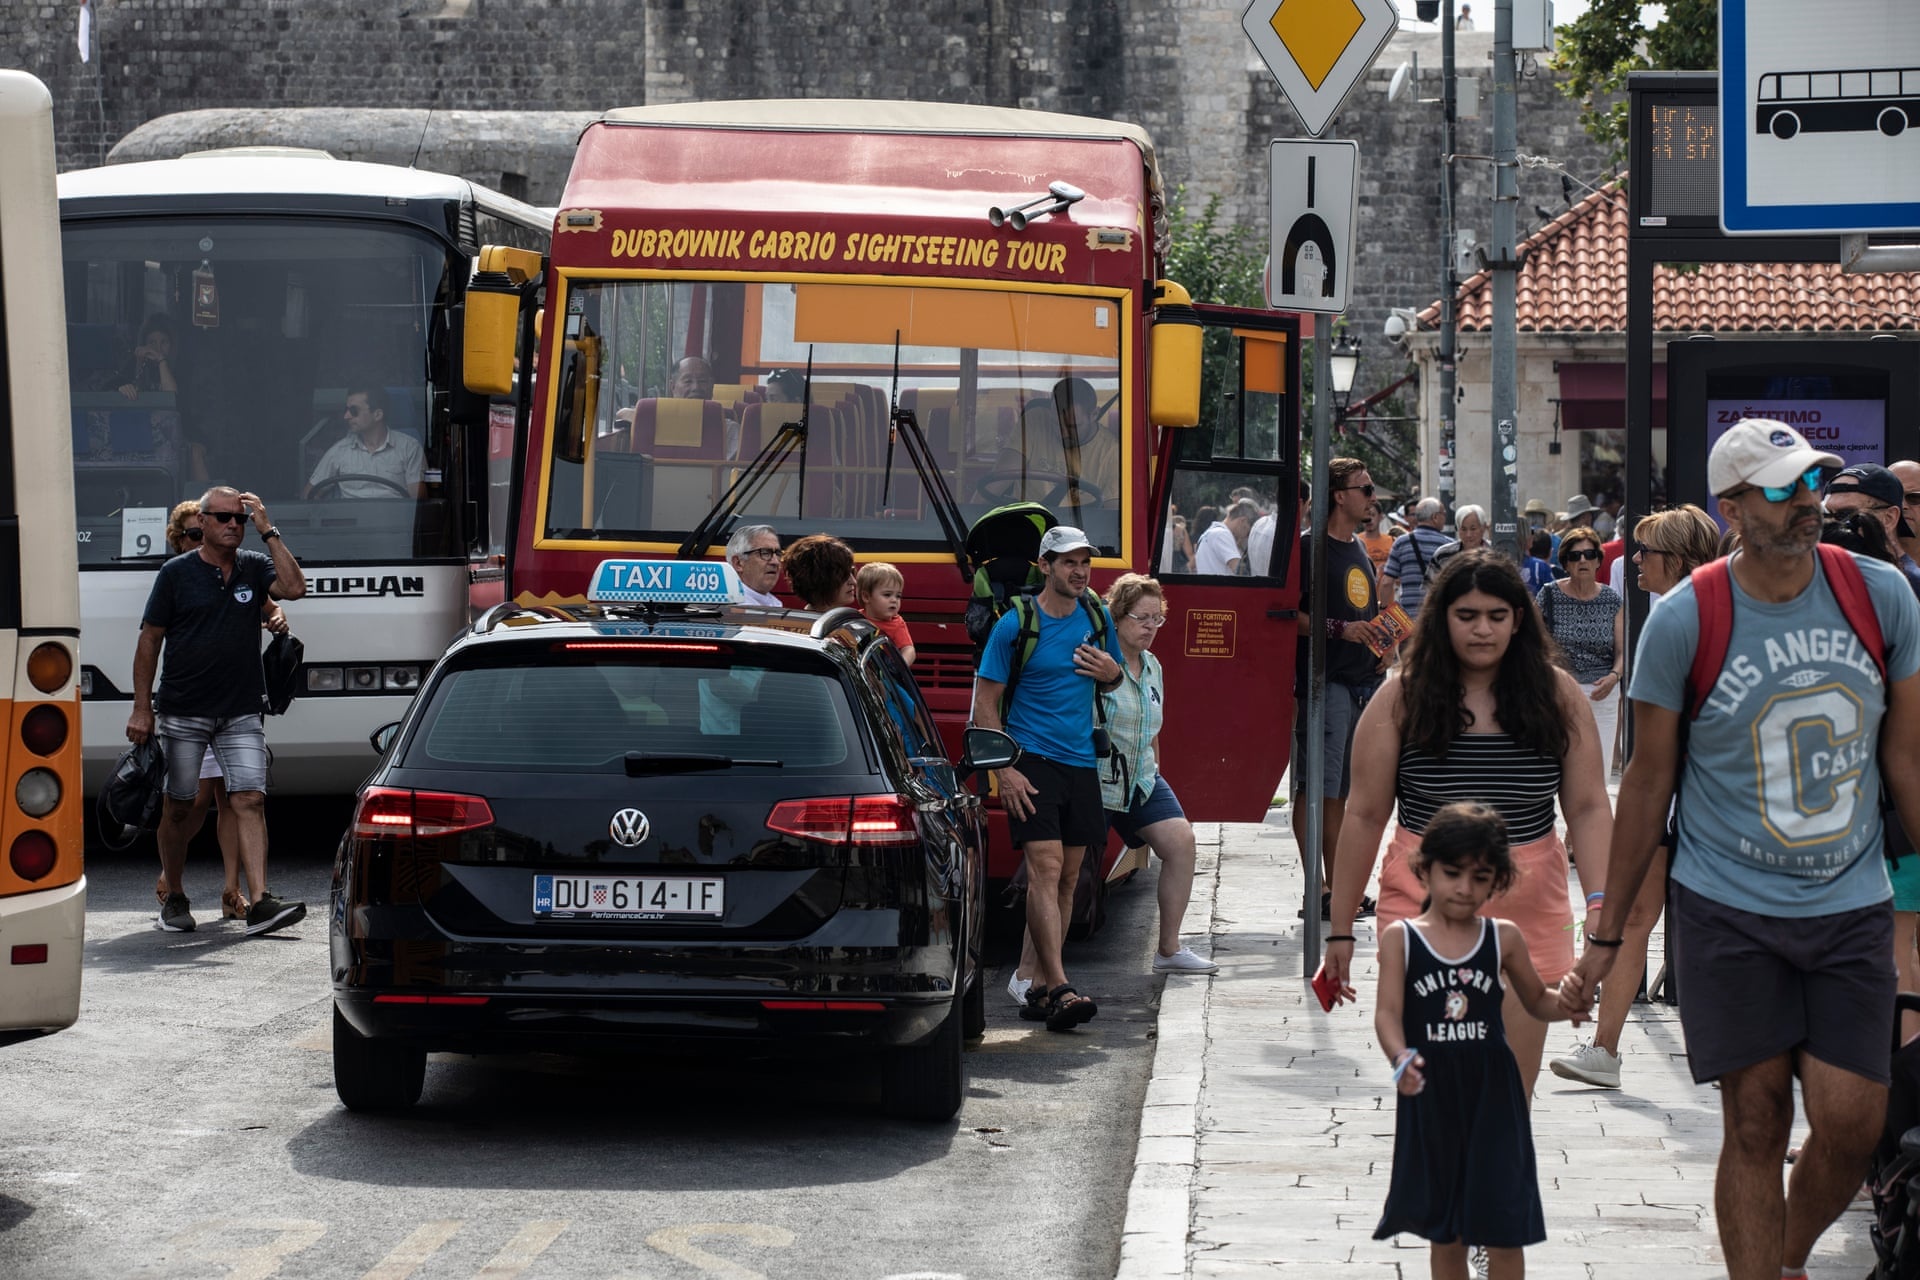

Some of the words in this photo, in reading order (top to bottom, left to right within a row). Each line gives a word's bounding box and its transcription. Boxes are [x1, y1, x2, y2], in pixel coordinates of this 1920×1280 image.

[611, 228, 745, 260] DUBROVNIK
[749, 230, 836, 262] CABRIO
[844, 232, 999, 268] SIGHTSEEING
[1006, 241, 1067, 274] TOUR
[77, 531, 92, 543] OZ
[136, 534, 152, 555] 9
[609, 565, 672, 589] TAXI
[685, 573, 720, 591] 409
[1706, 654, 1764, 716] LOS
[1740, 837, 1787, 867] MADE
[1797, 855, 1815, 867] IN
[1823, 848, 1851, 866] THE
[537, 897, 551, 907] HR
[555, 879, 590, 909] DU
[612, 880, 716, 910] 614-IF
[591, 912, 665, 920] PerformanceCars.hr
[1426, 1021, 1488, 1042] LEAGUE
